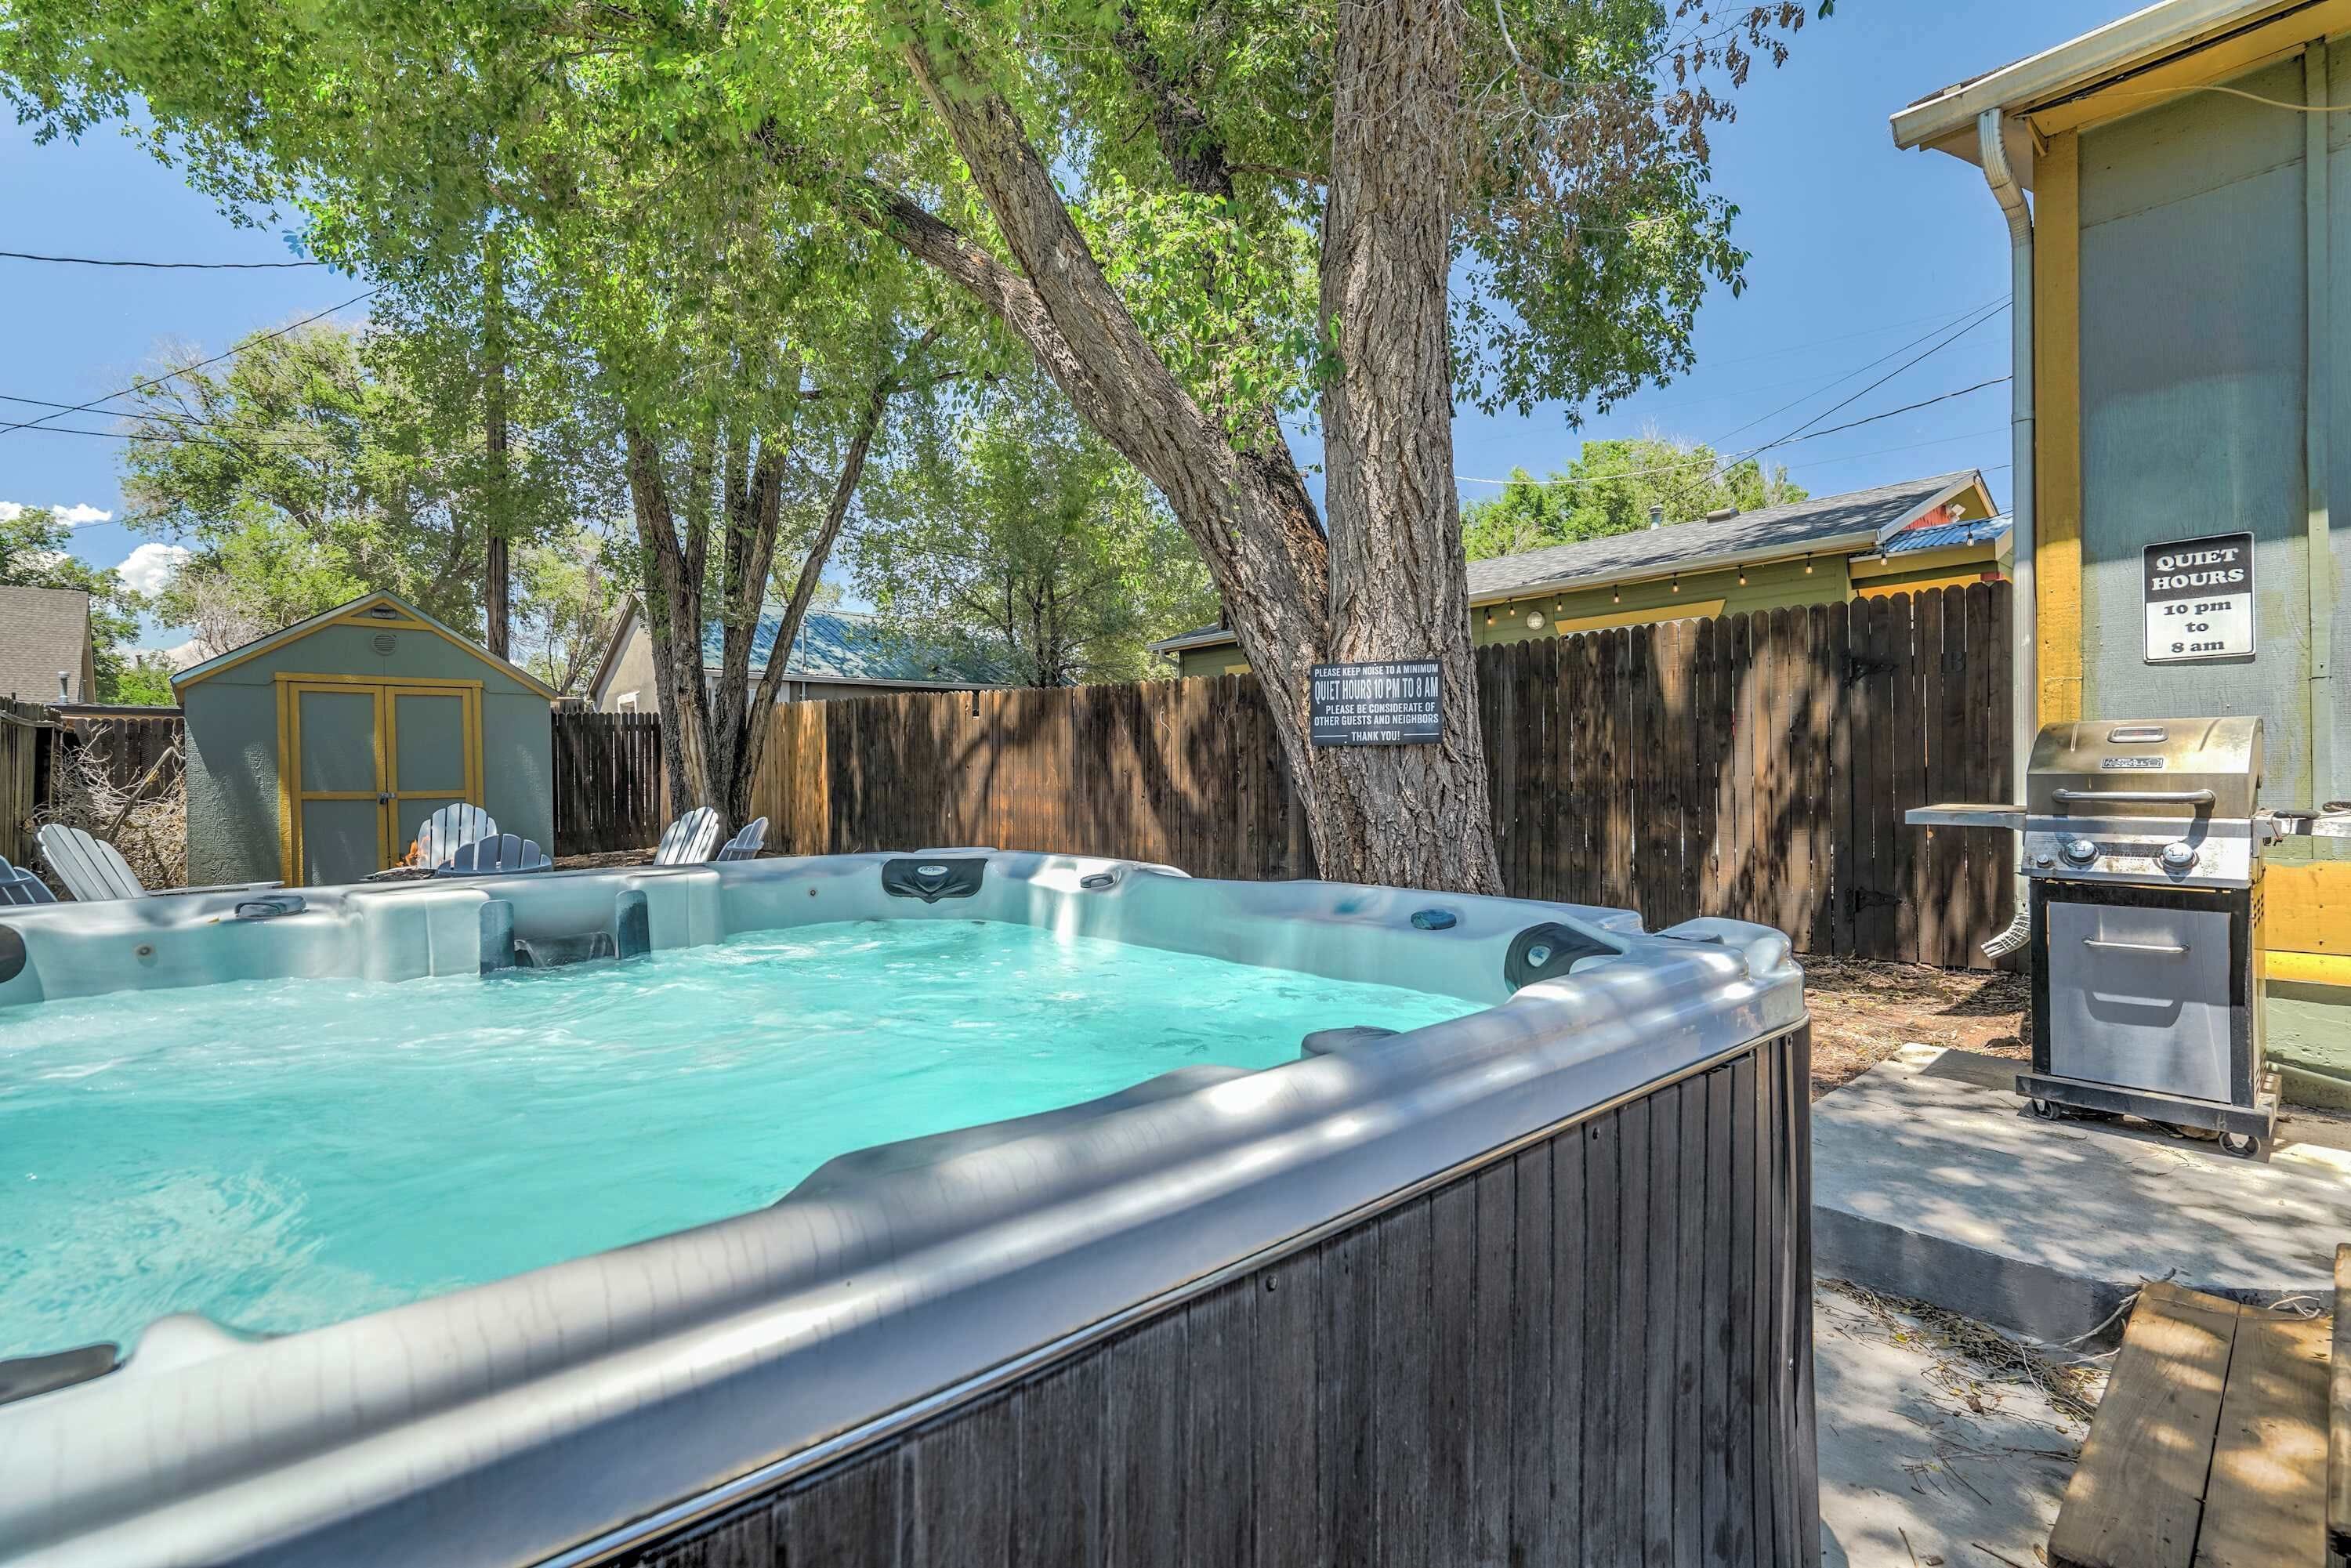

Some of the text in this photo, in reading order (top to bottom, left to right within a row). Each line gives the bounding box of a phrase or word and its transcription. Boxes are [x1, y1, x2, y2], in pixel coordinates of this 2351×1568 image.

[2157, 548, 2239, 571] QUIET
[2152, 569, 2244, 590] HOURS
[2164, 601, 2232, 615] 10 pm
[2185, 622, 2208, 632] to
[2172, 641, 2224, 653] 8 am
[1315, 668, 1340, 677] PLEASE
[1342, 667, 1360, 675] KEEP
[1363, 666, 1383, 675] NOISE
[1396, 665, 1401, 674] A
[1404, 664, 1438, 673] MINIMUM
[1315, 676, 1438, 704] QUIET HOURS 10 PM TO 8 AM
[1326, 702, 1435, 715] PLEASE BE CONSIDERATE OF
[1314, 714, 1438, 726] OTHER GUESTS AND NEIGHBORS
[1352, 731, 1400, 741] THANK YOU!
